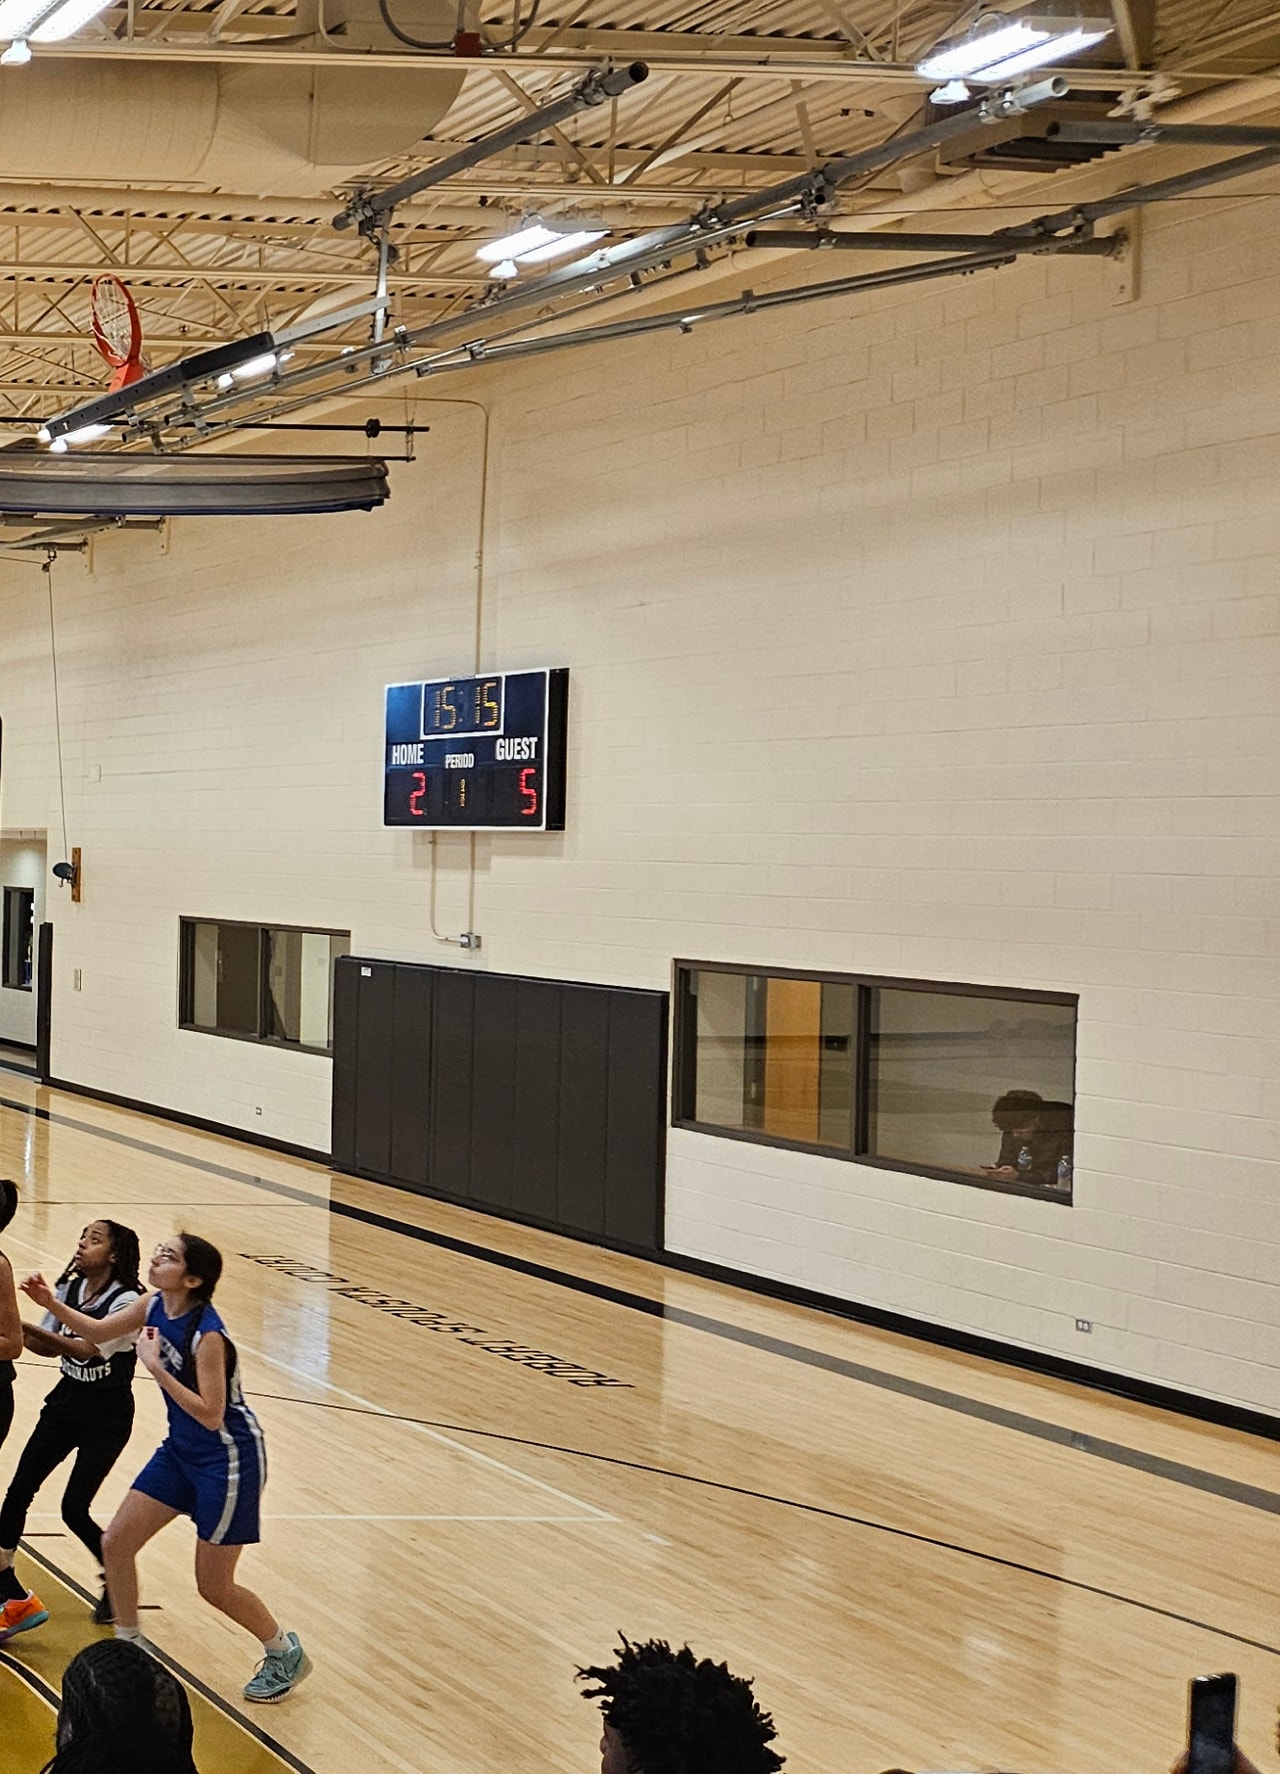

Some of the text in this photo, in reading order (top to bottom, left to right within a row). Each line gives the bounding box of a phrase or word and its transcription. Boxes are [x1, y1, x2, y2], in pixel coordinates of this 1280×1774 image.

[392, 743, 425, 765] HOME
[444, 753, 475, 769] PERIOD
[495, 737, 538, 760] GUEST
[409, 772, 426, 816] 2
[519, 768, 537, 815] 5
[236, 1253, 350, 1282] COURT
[456, 1338, 637, 1388] ROBERT
